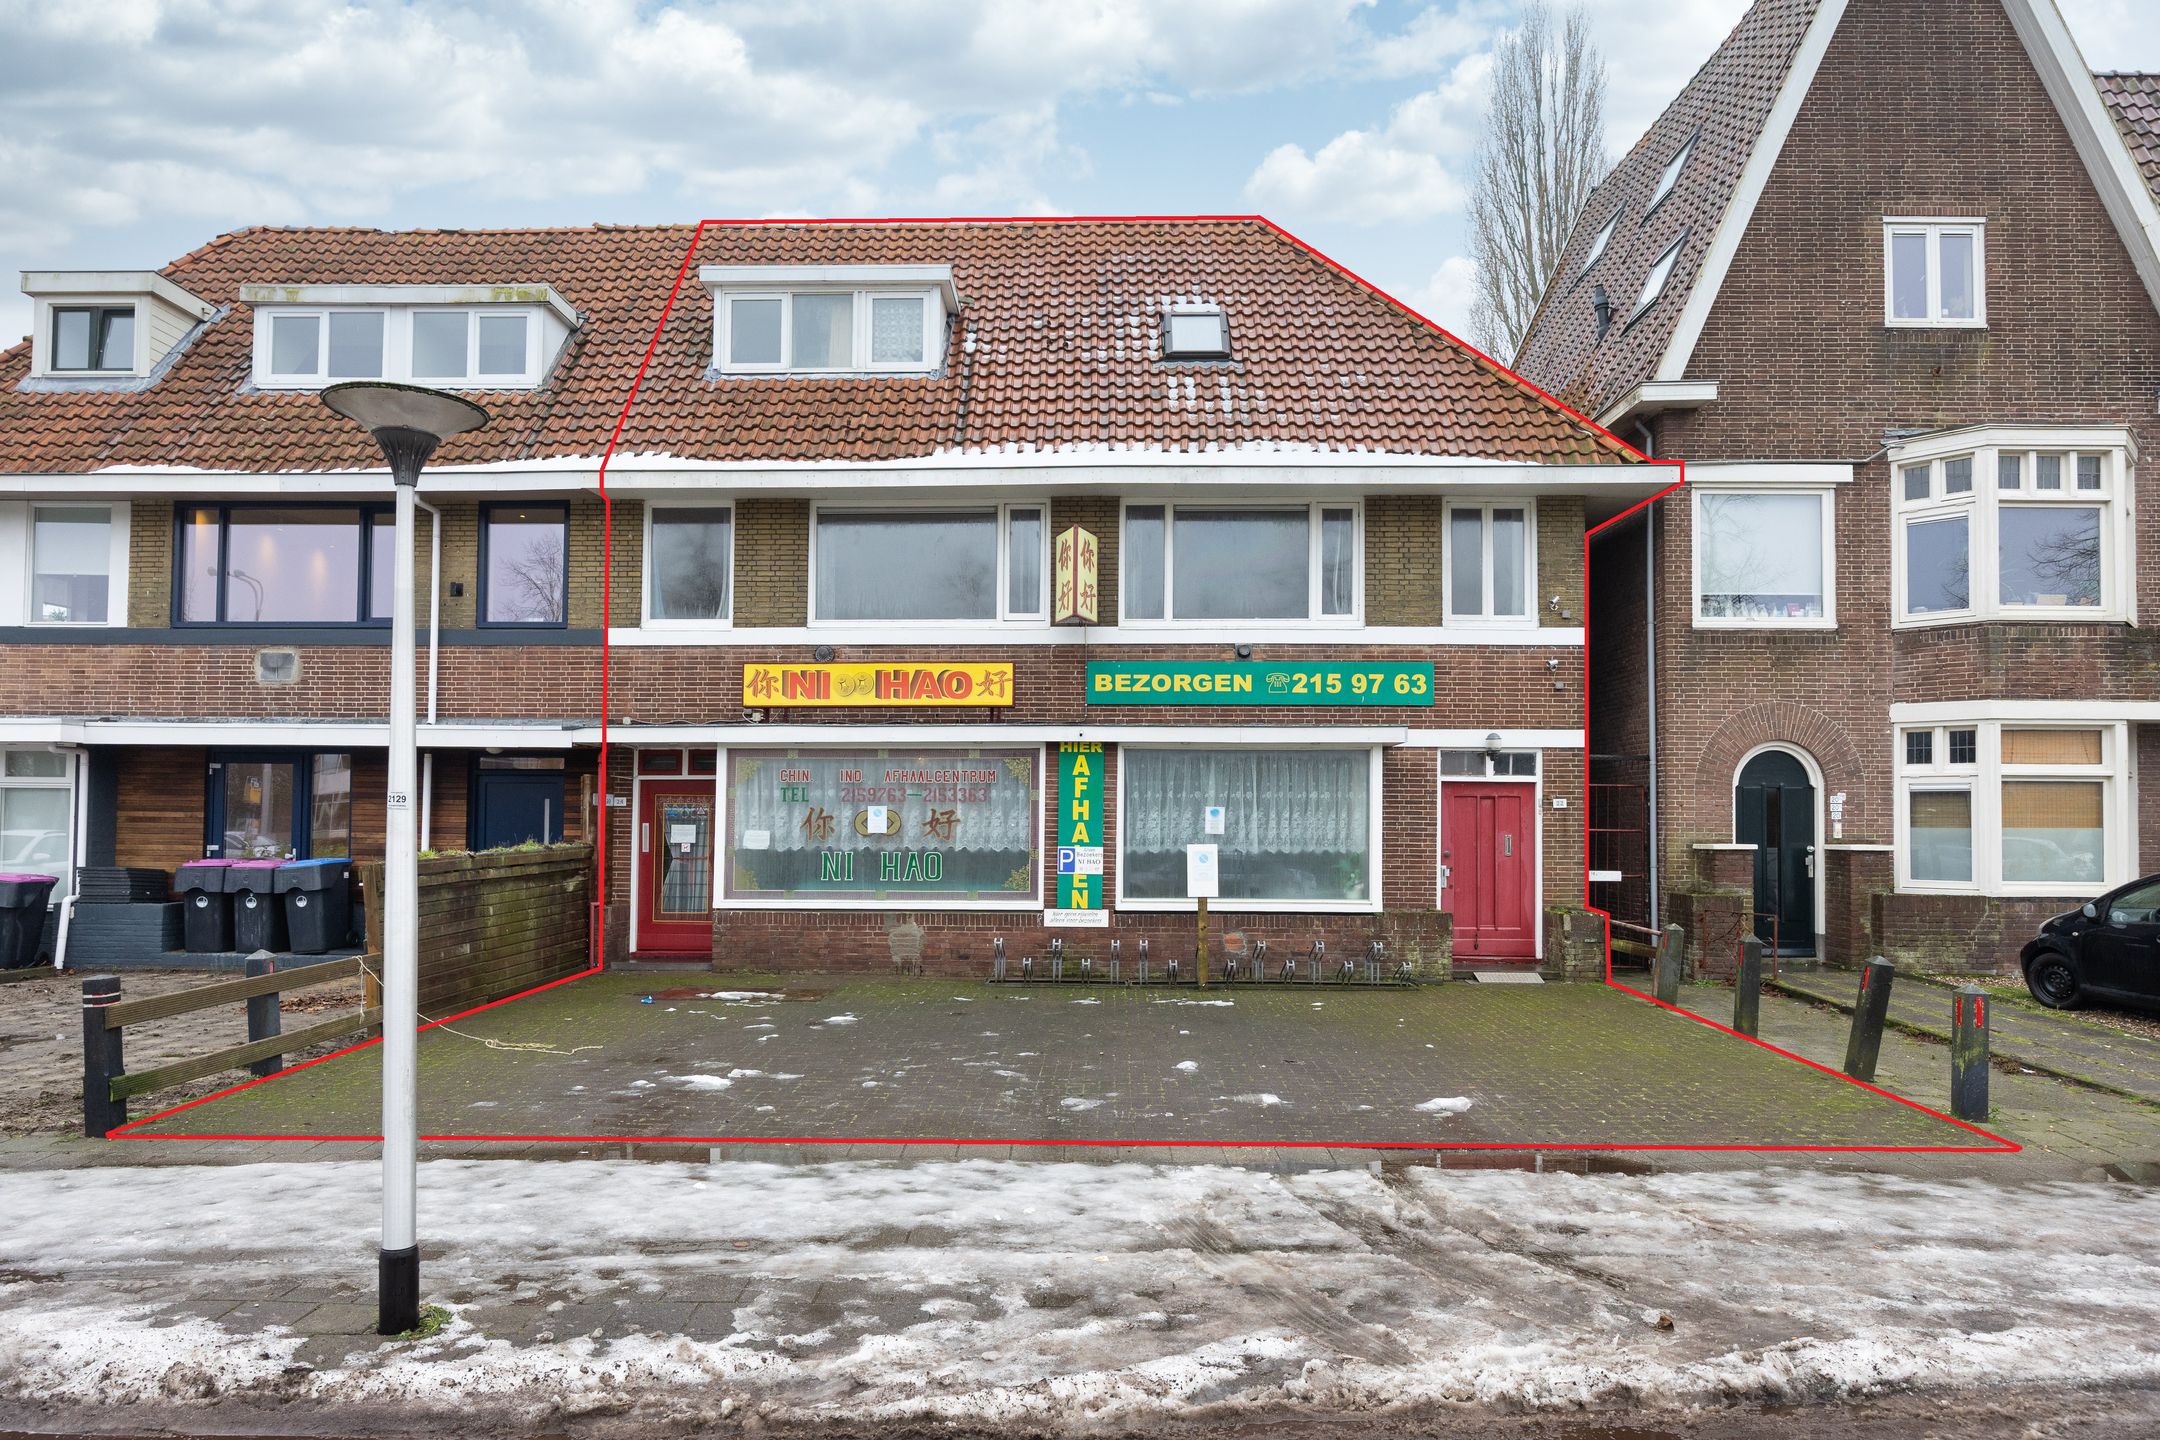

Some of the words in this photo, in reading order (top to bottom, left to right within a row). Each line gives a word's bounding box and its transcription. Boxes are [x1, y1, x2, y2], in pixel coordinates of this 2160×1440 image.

[1080, 537, 1096, 615] 你好
[745, 667, 780, 700] 你
[782, 669, 831, 700] NI
[875, 669, 974, 700] HAO
[976, 669, 1013, 698] 好
[1094, 674, 1253, 693] BEZORGEN
[1292, 673, 1342, 694] 215
[1351, 673, 1385, 694] 97
[1393, 673, 1428, 694] 63
[1060, 742, 1102, 752] HIER
[884, 769, 997, 784] AFHAALCENTRUM
[388, 795, 406, 803] 2129
[780, 787, 810, 802] TEL
[800, 806, 836, 841] 你
[921, 807, 961, 841] 好
[1072, 754, 1091, 909] AFHAEN
[821, 851, 854, 881] NI
[880, 851, 943, 881] HAO
[1060, 849, 1074, 871] P
